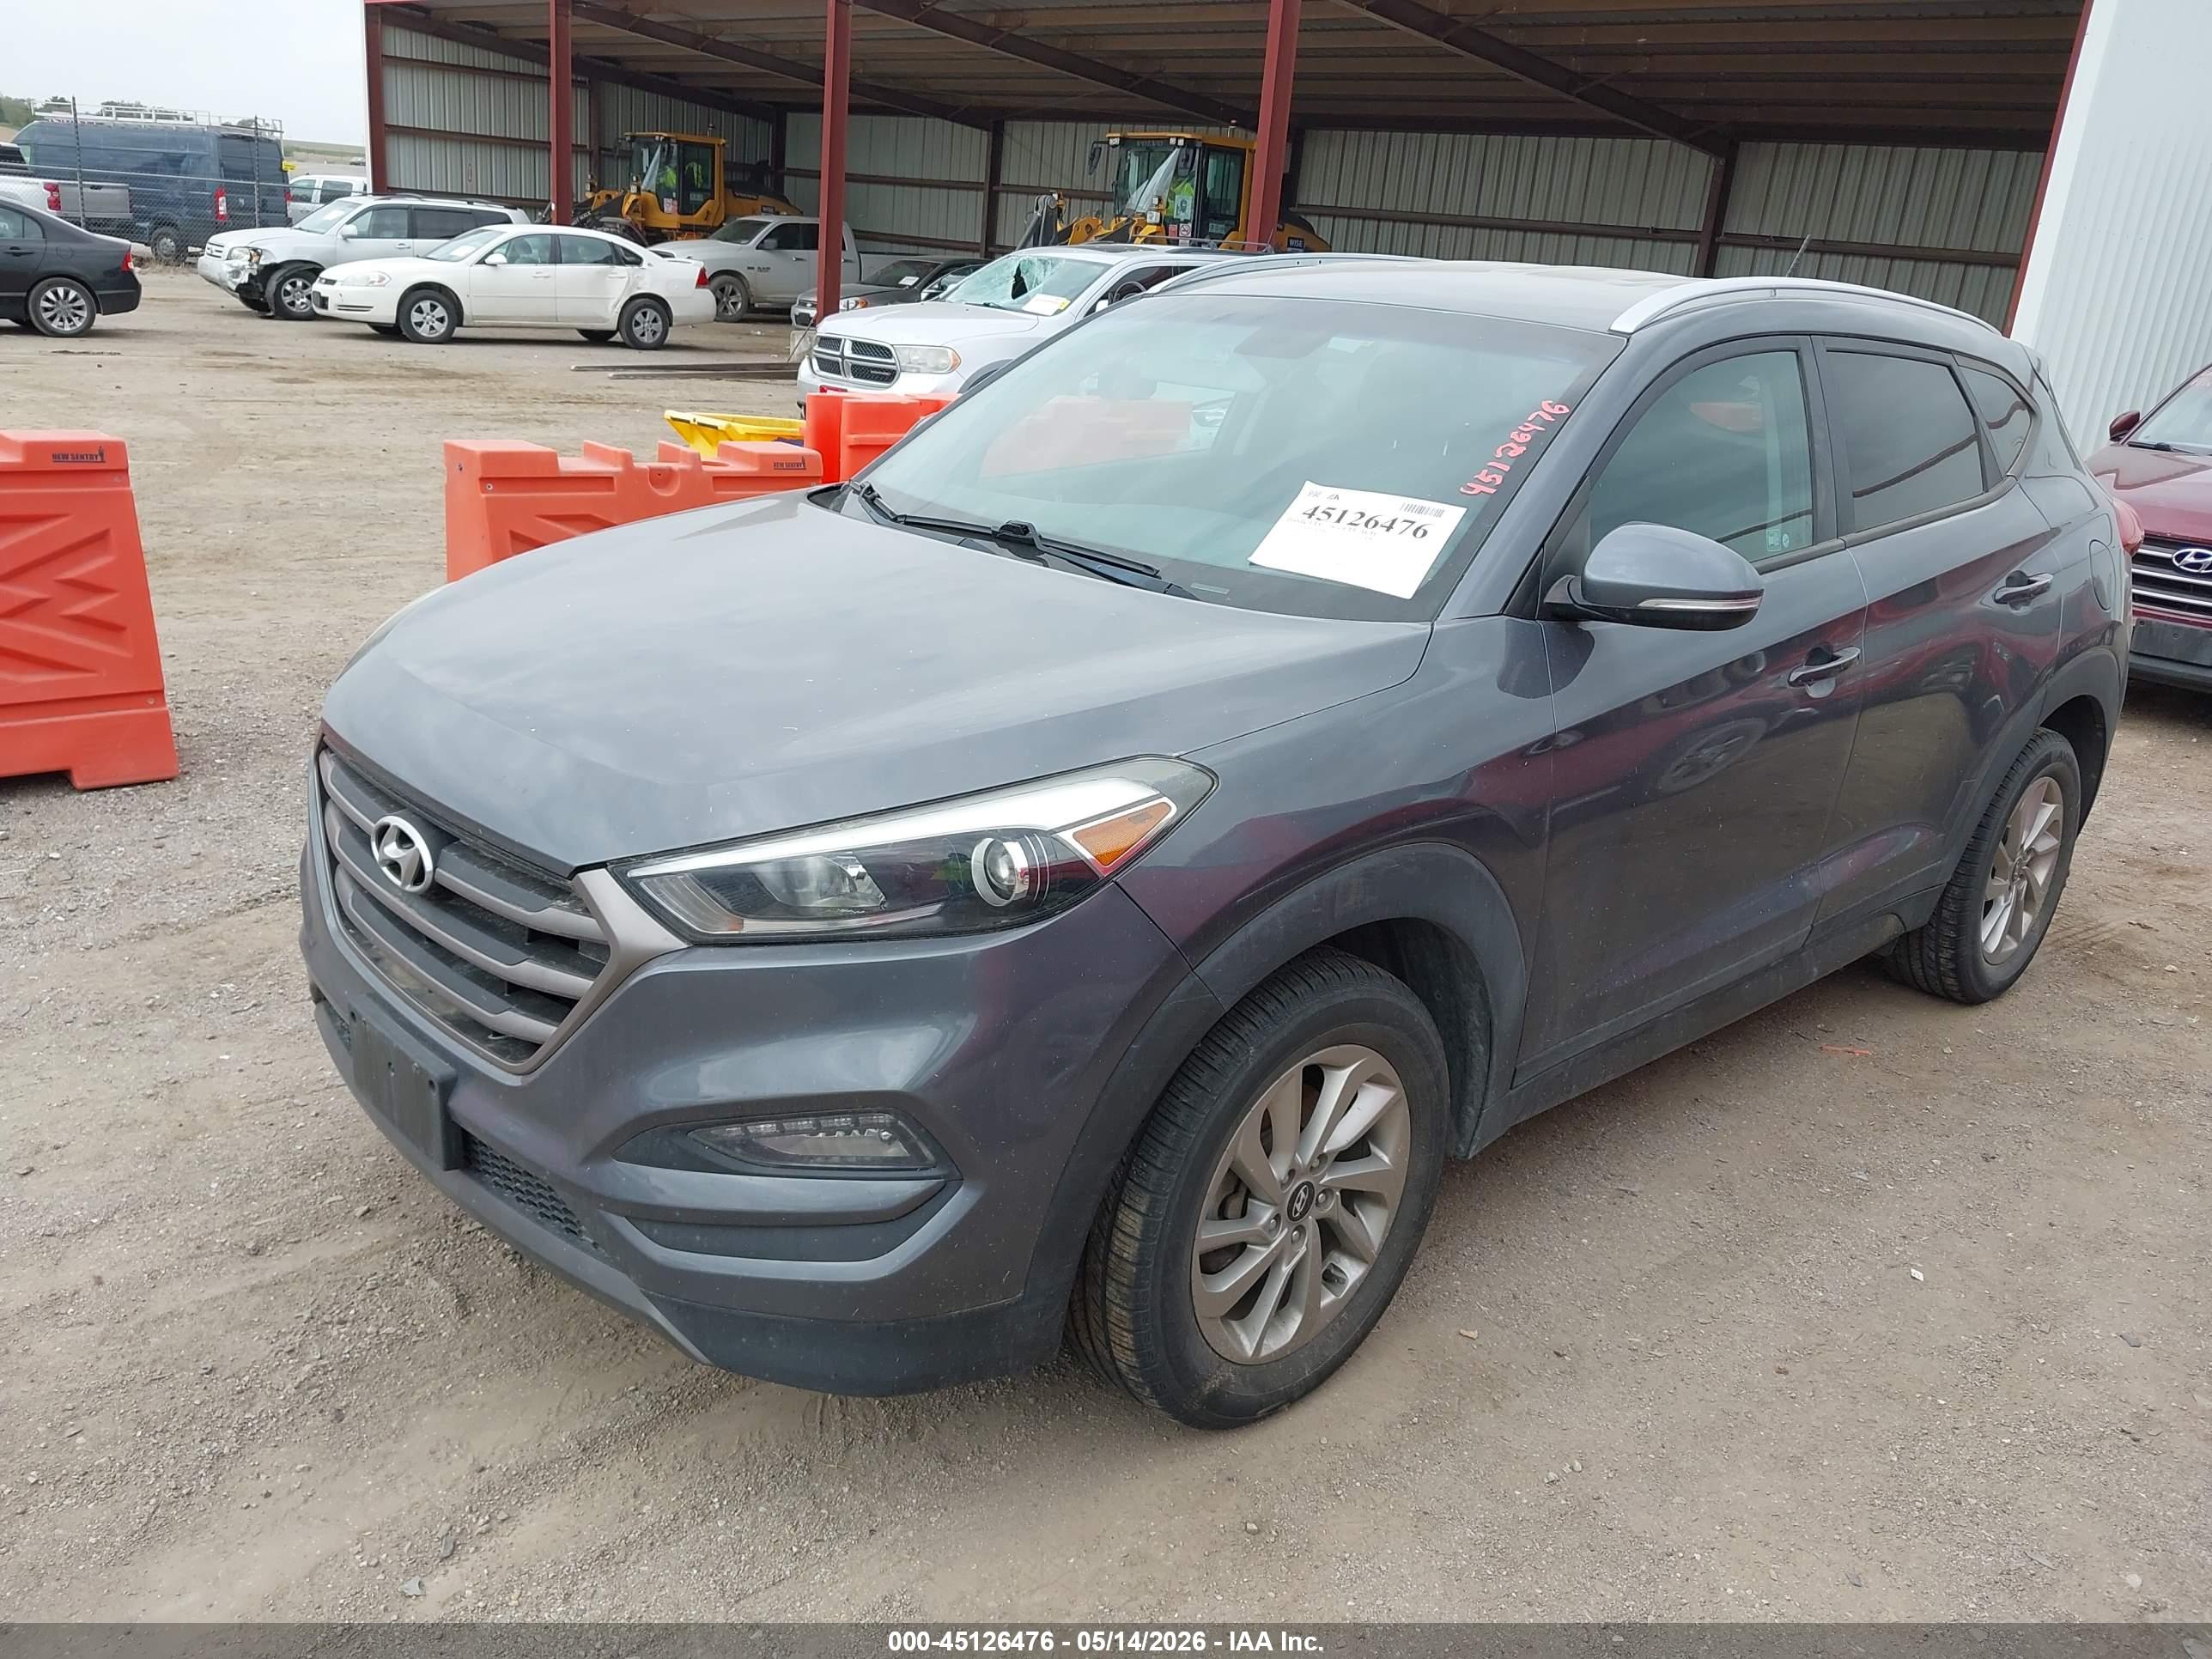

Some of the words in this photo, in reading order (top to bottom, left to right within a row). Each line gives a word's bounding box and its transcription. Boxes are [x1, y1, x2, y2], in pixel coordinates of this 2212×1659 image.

[1289, 239, 1304, 248] WISE
[1460, 400, 1570, 495] 45126476
[1302, 505, 1433, 539] 45126476
